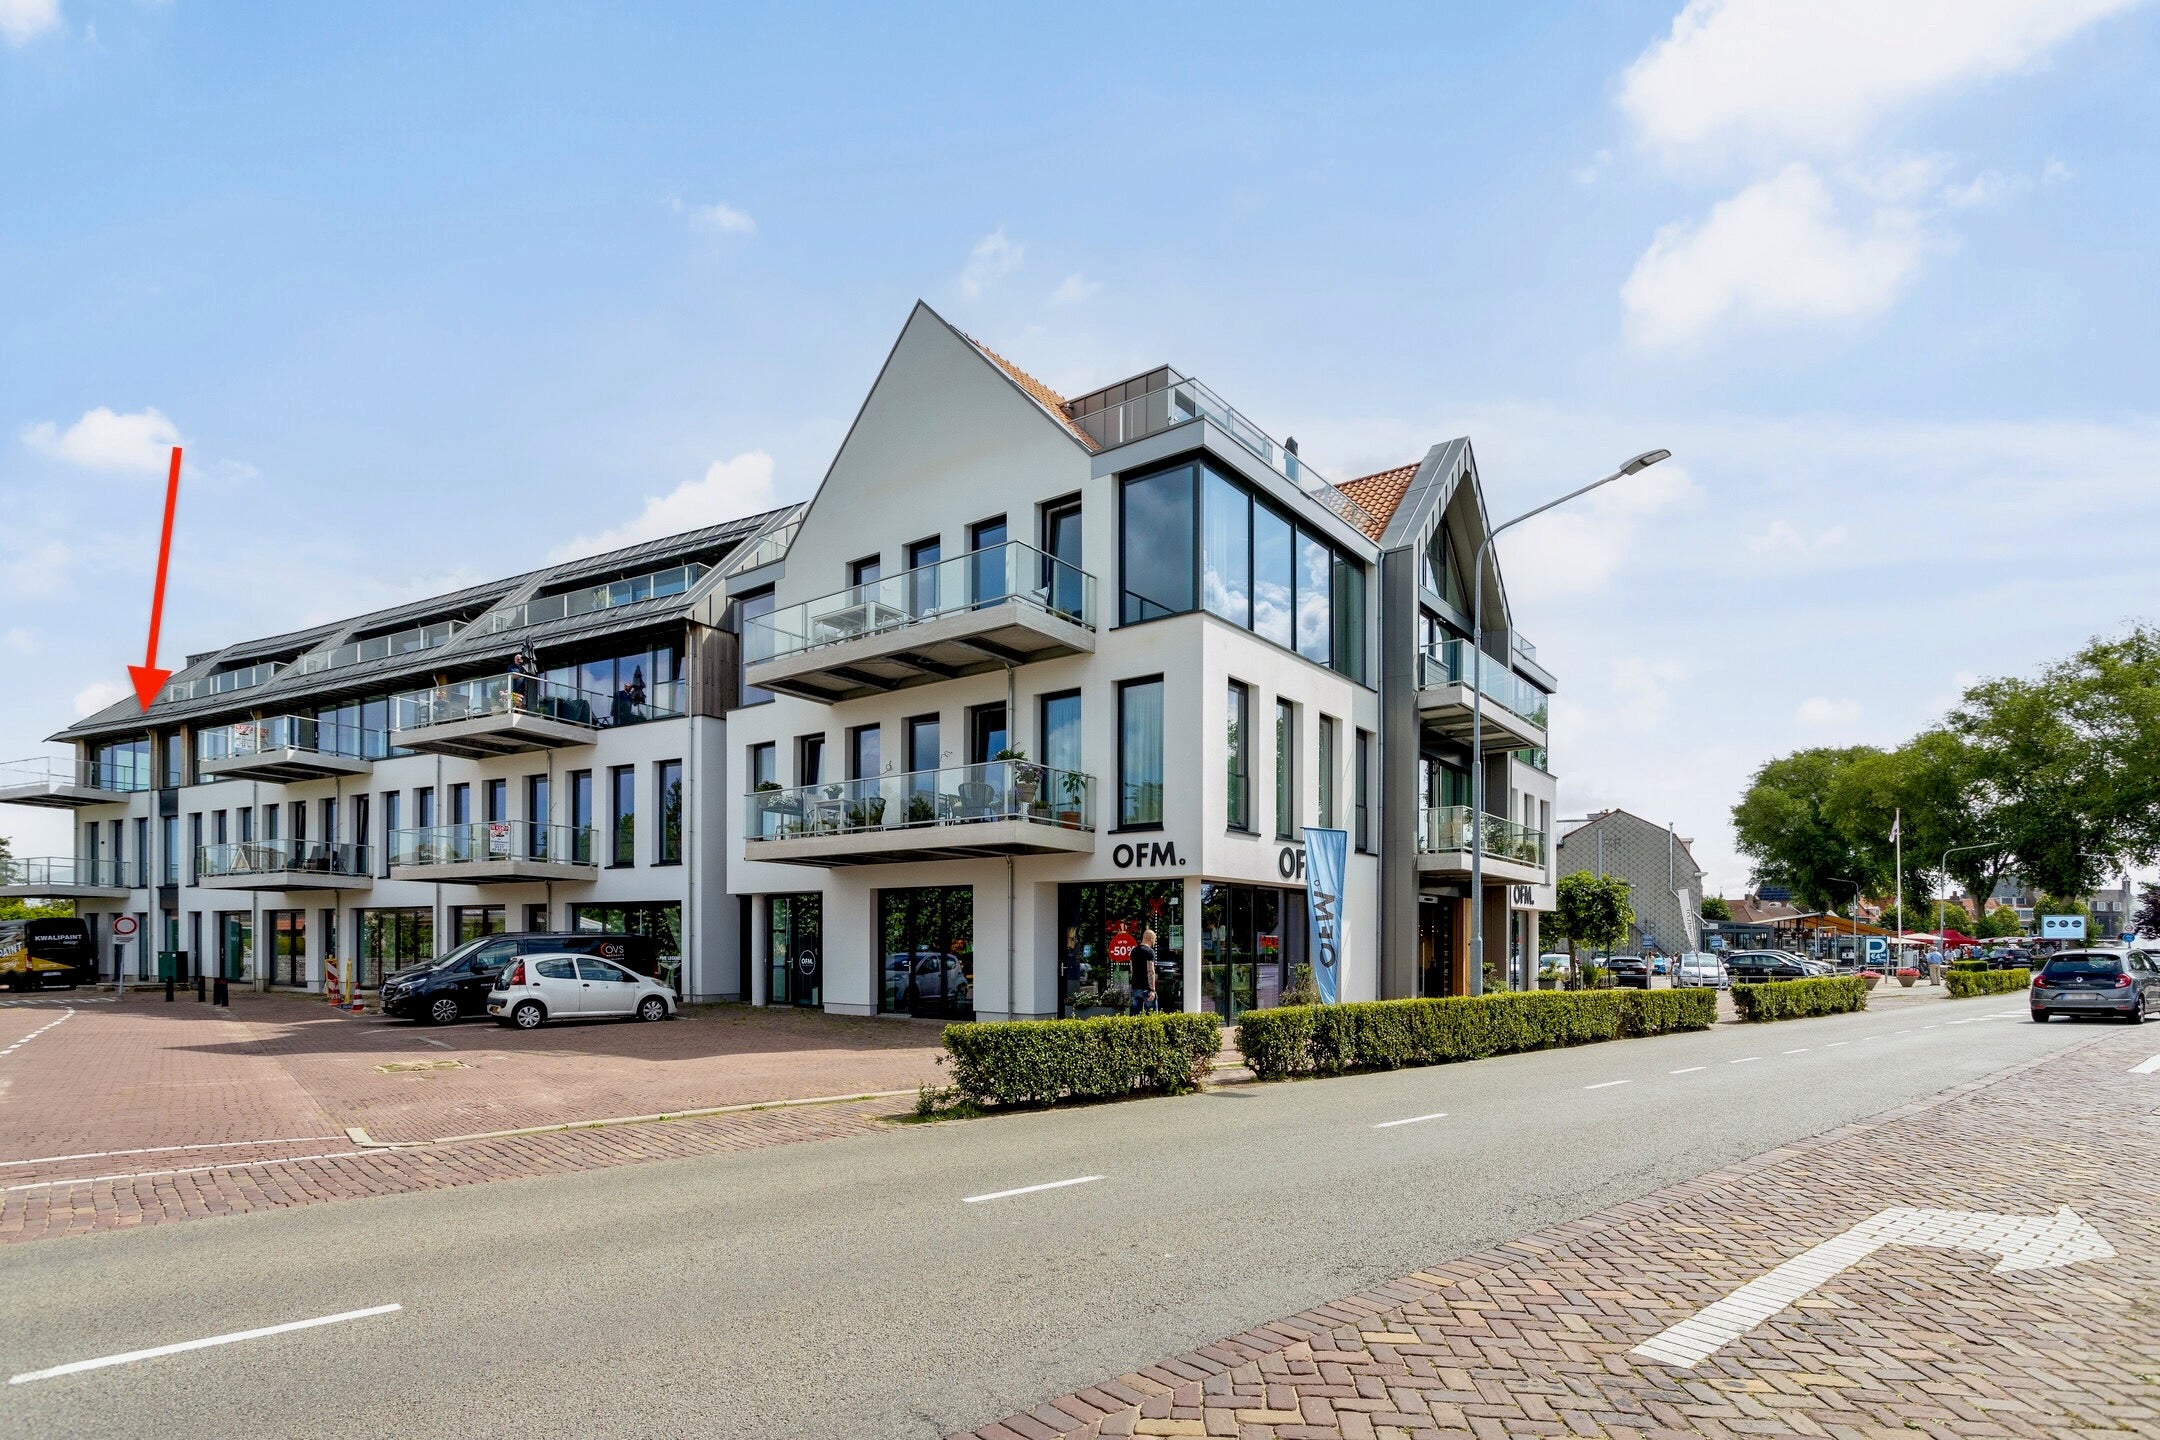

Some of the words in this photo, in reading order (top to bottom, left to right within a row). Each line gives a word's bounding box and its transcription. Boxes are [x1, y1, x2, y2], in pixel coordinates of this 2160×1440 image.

[1113, 841, 1186, 868] OFM.
[1279, 847, 1306, 878] OF
[1513, 885, 1535, 905] OFM.
[605, 945, 624, 954] OVS
[1866, 939, 1886, 963] P
